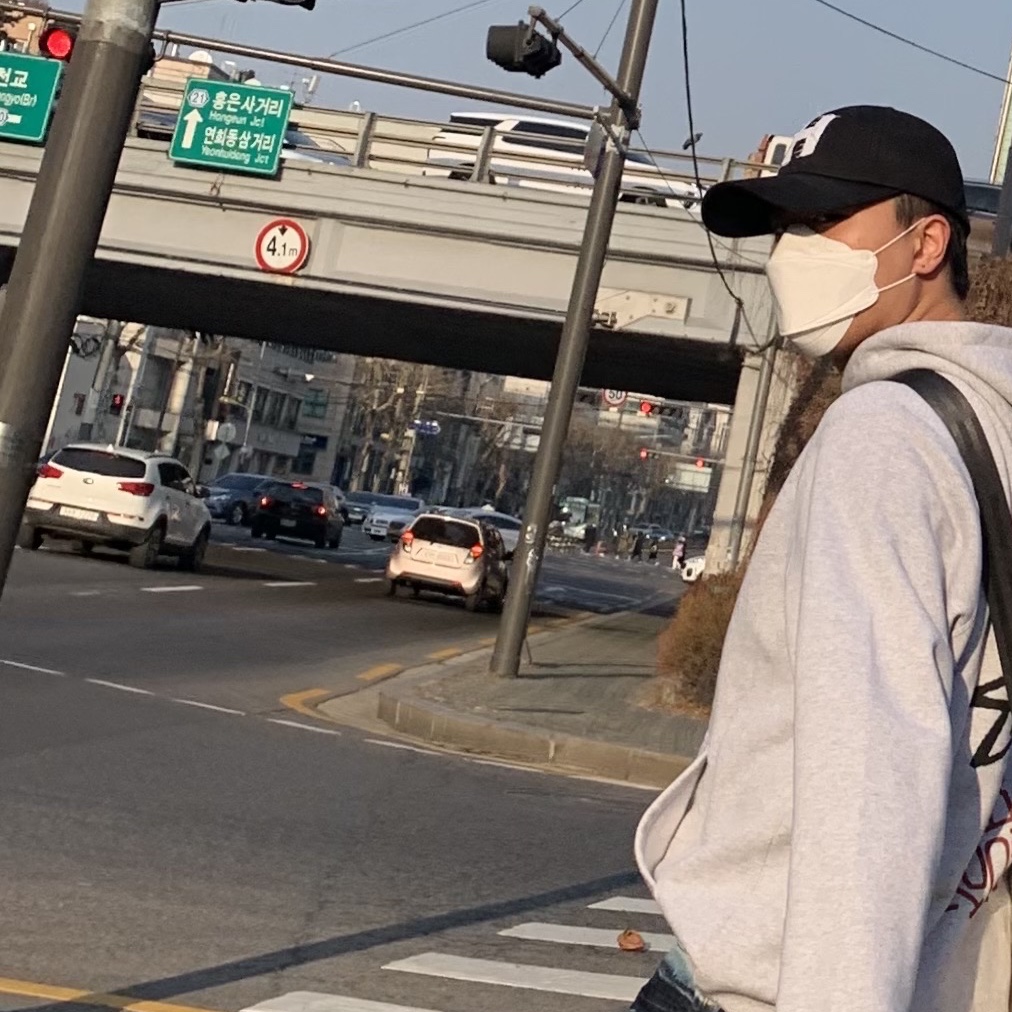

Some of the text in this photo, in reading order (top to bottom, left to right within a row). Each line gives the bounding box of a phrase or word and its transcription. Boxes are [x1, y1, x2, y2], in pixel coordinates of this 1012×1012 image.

[192, 92, 205, 104] 21
[213, 91, 284, 118] 홍은사거리
[203, 126, 276, 153] 연희동삼거리
